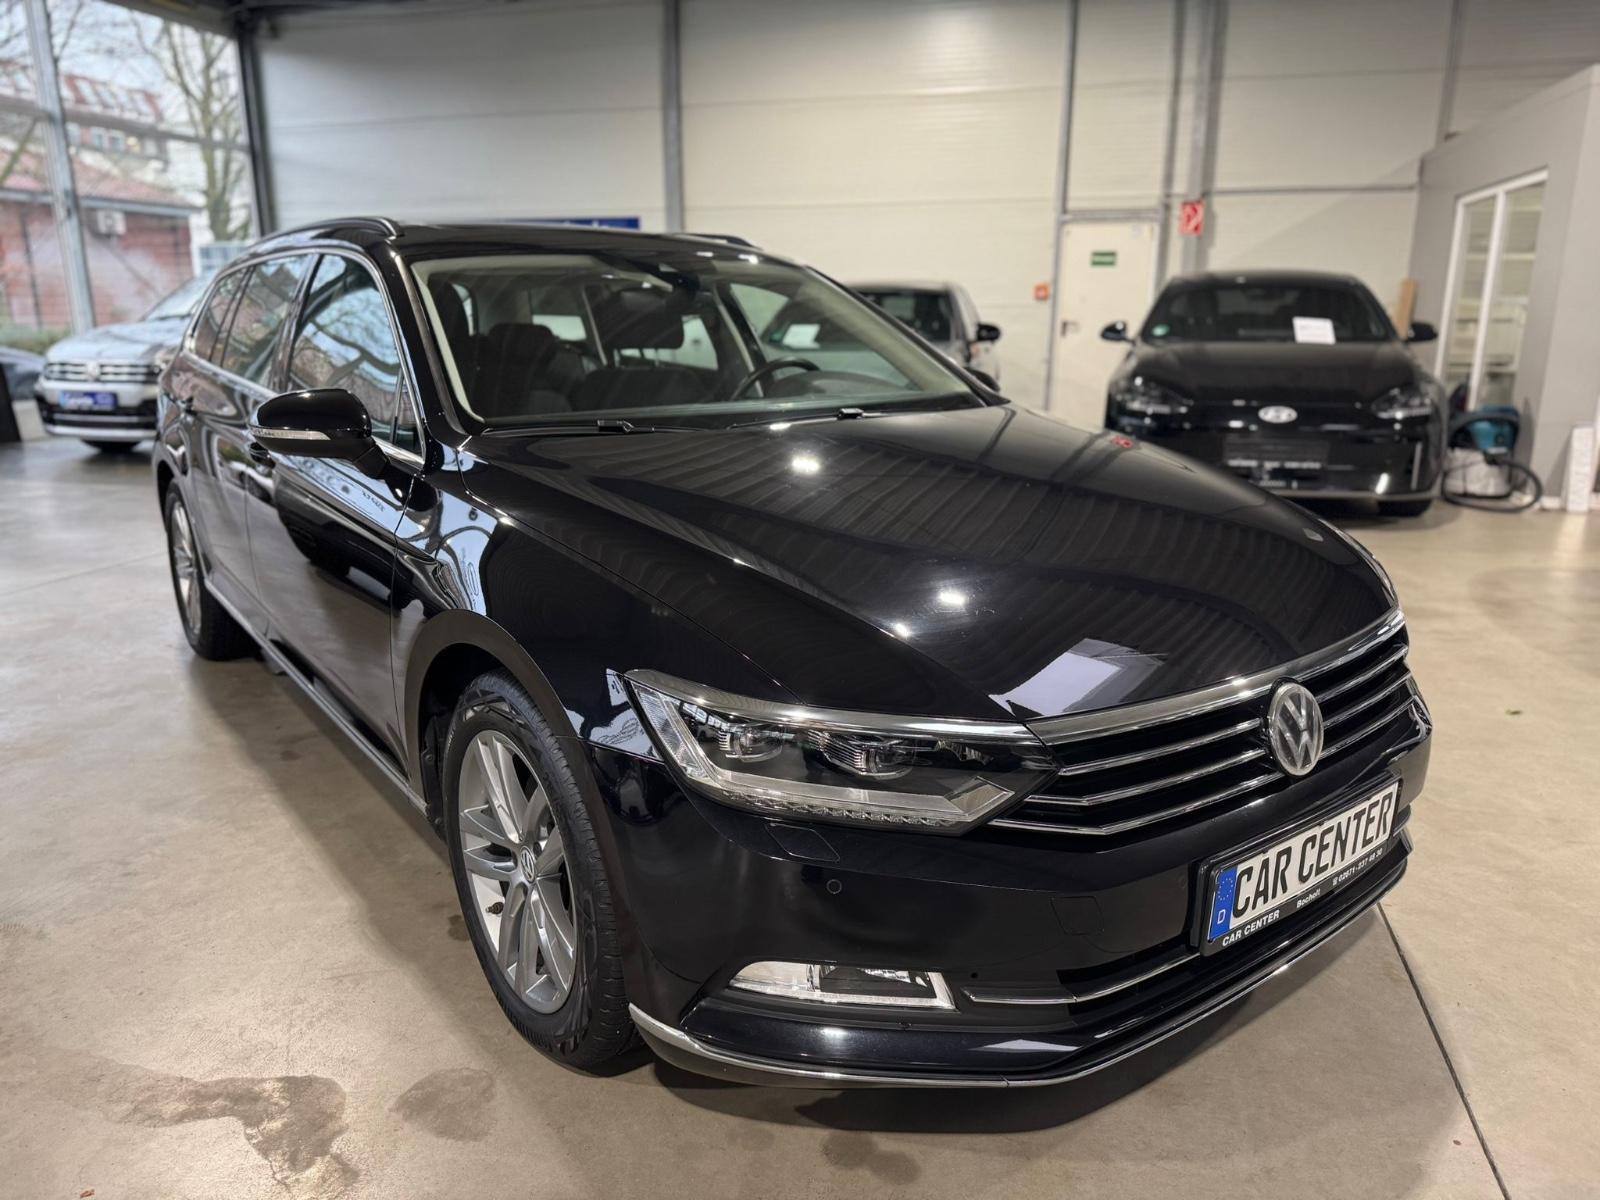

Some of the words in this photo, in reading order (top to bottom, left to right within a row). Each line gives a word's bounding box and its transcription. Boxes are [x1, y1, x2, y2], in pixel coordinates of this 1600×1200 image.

[1232, 846, 1292, 918] CAR
[1297, 791, 1393, 884] CENTER
[1217, 909, 1226, 925] D
[1222, 929, 1242, 947] CAR
[1244, 909, 1280, 935] CENTER
